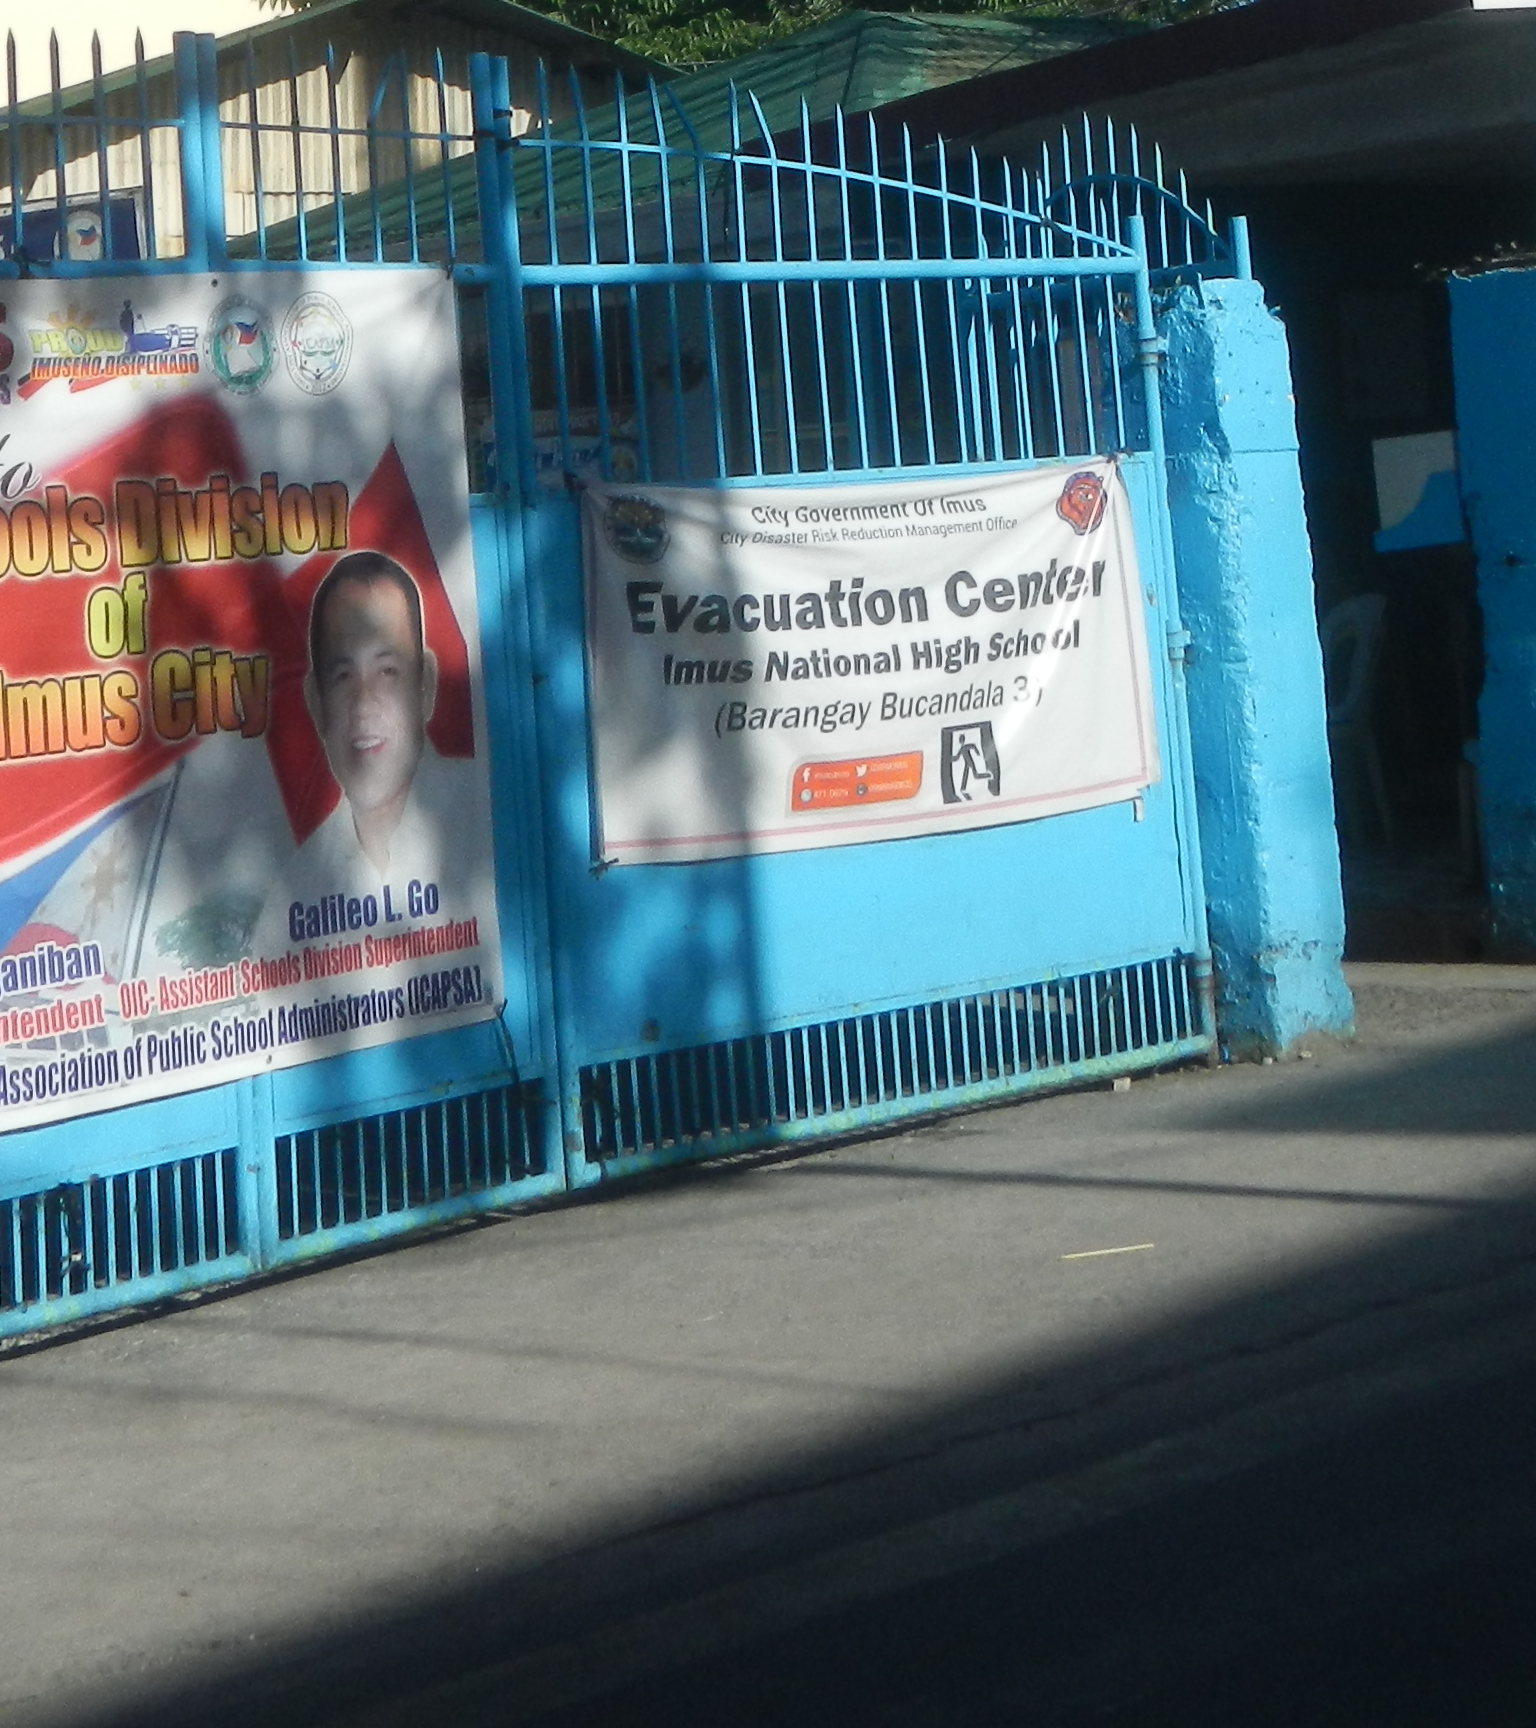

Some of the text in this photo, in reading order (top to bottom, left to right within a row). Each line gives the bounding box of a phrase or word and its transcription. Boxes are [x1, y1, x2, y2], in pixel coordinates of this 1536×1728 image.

[28, 328, 125, 355] PROUD
[115, 472, 350, 568] Division
[720, 516, 1019, 548] City Disaster Risk Reduction Management Office
[750, 495, 988, 528] City Government Of Imus
[88, 572, 148, 659] of
[625, 556, 1108, 635] Evacuation Center
[663, 619, 1081, 686] Imus National High School
[150, 648, 270, 740] City
[713, 696, 872, 738] (Barangay
[879, 682, 1005, 723] Bucandala
[288, 878, 440, 943] Galileo L. Go
[158, 962, 237, 1012] Assistant
[240, 947, 302, 995] Schools
[302, 940, 363, 982] Division
[364, 916, 481, 970] Superintendent
[123, 1035, 143, 1081] of
[146, 1023, 207, 1076] Public
[210, 1006, 275, 1061] School
[277, 986, 406, 1045] Administrators
[406, 964, 484, 1018] (ICAPSA)
